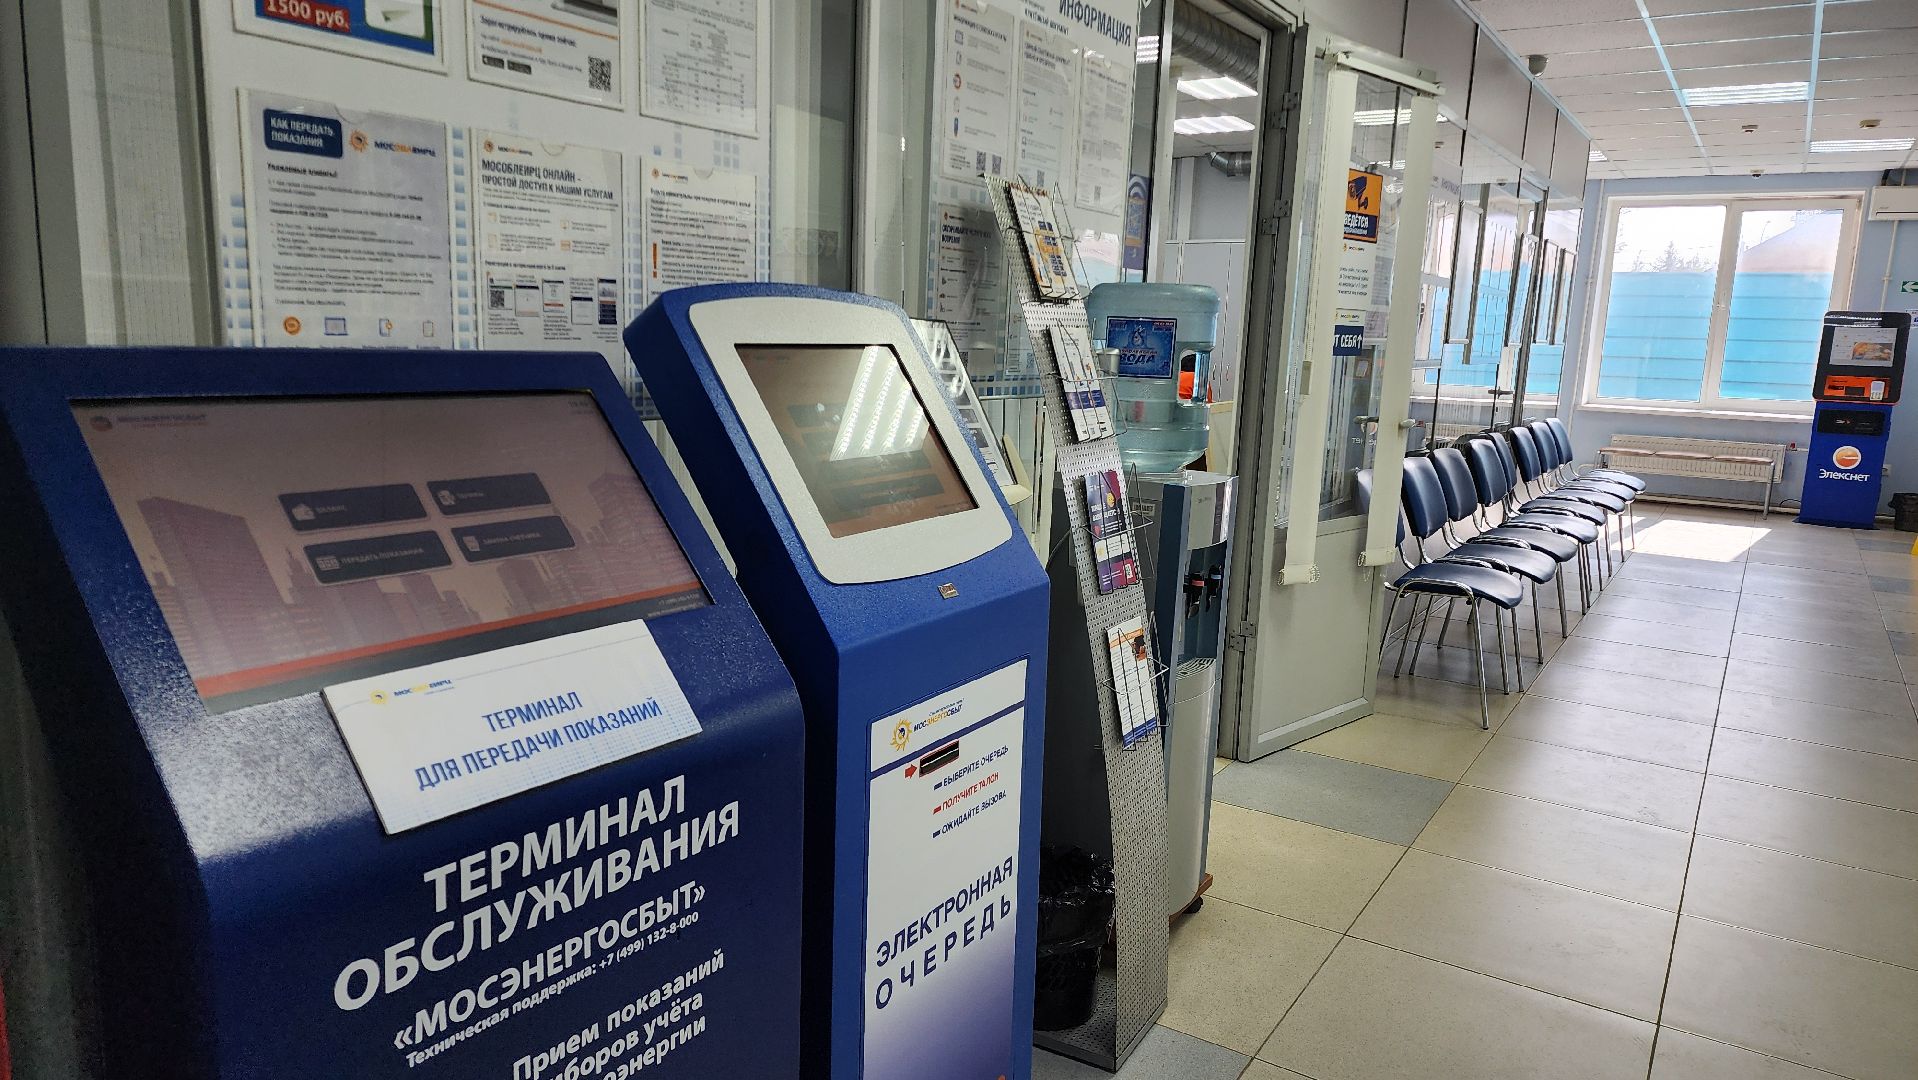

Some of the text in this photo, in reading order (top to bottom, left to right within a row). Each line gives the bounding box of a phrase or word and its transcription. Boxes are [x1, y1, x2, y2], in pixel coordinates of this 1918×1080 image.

[267, 0, 349, 29] 1500 руб.
[1059, 0, 1132, 47] ИНФОРМАЦИЯ
[270, 117, 334, 136] КАК ПЕРЕДАТЬ
[271, 131, 324, 148] ПОКАЗАНИЯ
[482, 159, 541, 181] МОСОБЛЕИРЦ
[542, 168, 575, 183] ОНЛАЙН
[482, 174, 517, 188] ПРОСТОЙ
[518, 178, 548, 191] ДОСТУП
[555, 185, 582, 197] НАШИМ
[583, 190, 614, 200] УСЛУГАМ
[1340, 335, 1357, 347] СЕБЯ
[1818, 468, 1871, 482] Элекснет
[482, 691, 583, 733] ТЕРМИНАЛ
[414, 696, 663, 792] ДЛЯ ПЕРЕДАЧИ ПОКАЗАНИЙ
[943, 745, 1009, 787] ВЫБЕРИТЕ ОЧЕРЕДЬ
[941, 790, 1007, 834] ОЖИДАЙТЕ ВЫЗОВА
[942, 772, 999, 811] ПОЛУЧИТЕ ТАЛОН
[423, 774, 685, 912] ТЕРМИНАЛ
[333, 801, 740, 1011] ОБСЛУЖИВАНИЯ
[876, 856, 1013, 968] ЭЛЕКТРОННАЯ
[393, 880, 705, 1050] «МОСЭНЕРГОСБЫТ»
[875, 894, 1011, 1010] ОЧЕРЕДЬ
[406, 911, 699, 1068] Техническая поддержка: +7 (499) 132-8-000
[512, 948, 725, 1080] Прием показаний
[549, 992, 704, 1080] иборов учёта
[600, 1015, 707, 1080] оэнергии
